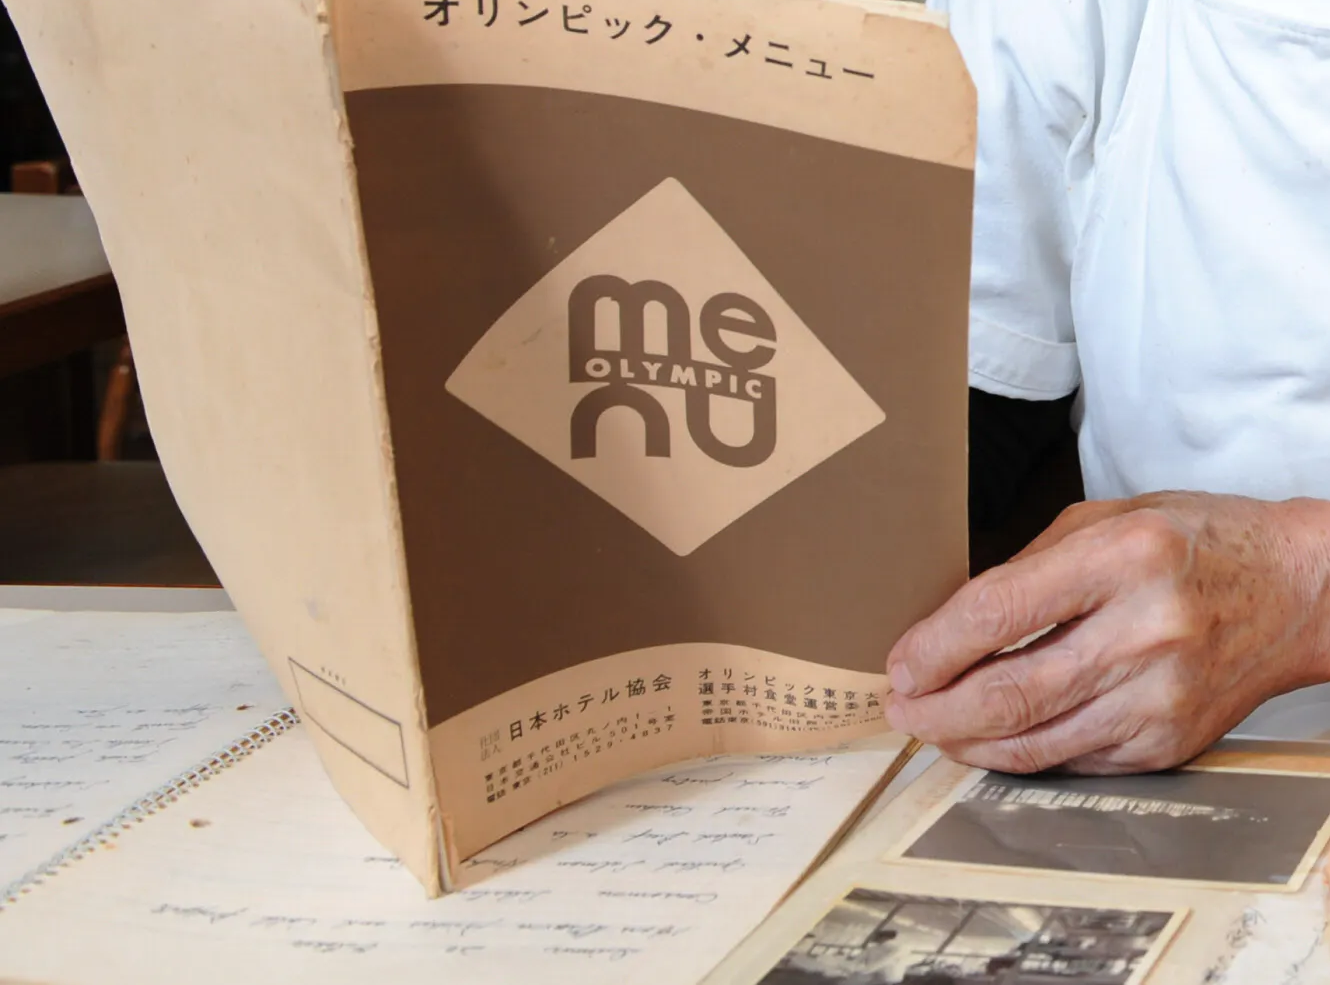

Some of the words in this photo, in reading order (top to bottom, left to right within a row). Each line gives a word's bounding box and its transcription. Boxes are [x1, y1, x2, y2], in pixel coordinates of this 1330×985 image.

[585, 357, 763, 400] OLYMPIC
[509, 673, 672, 742] 日本ホテル協会
